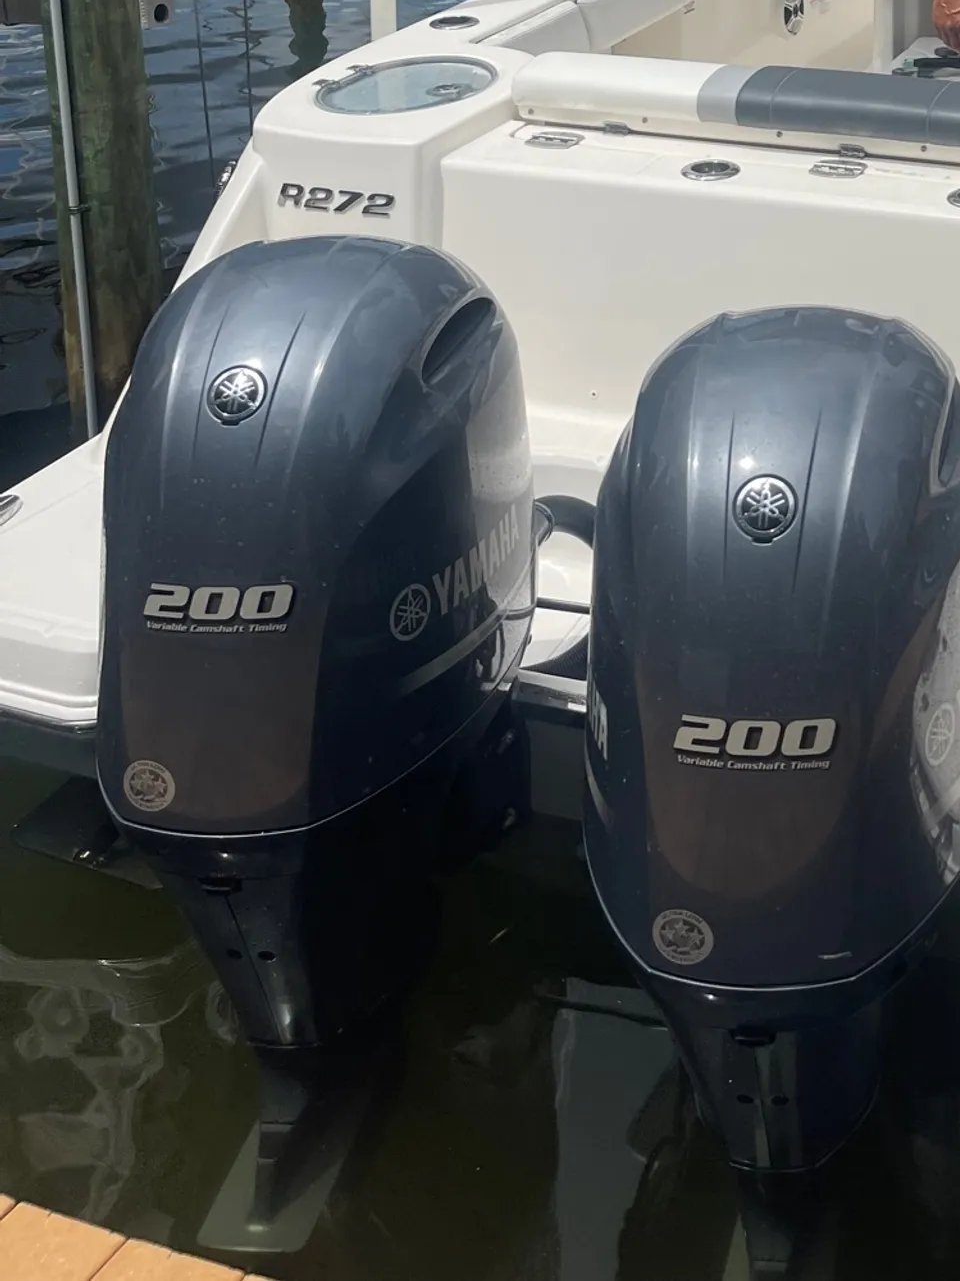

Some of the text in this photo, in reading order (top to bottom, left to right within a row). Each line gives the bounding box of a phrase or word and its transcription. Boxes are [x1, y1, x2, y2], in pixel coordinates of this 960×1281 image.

[277, 182, 396, 219] R272
[432, 502, 520, 616] YAMAHA
[143, 582, 294, 620] 200
[146, 620, 287, 633] Variable Camshaft Timing
[673, 714, 836, 757] 200
[677, 754, 830, 770] Variable Camshaft Timing
